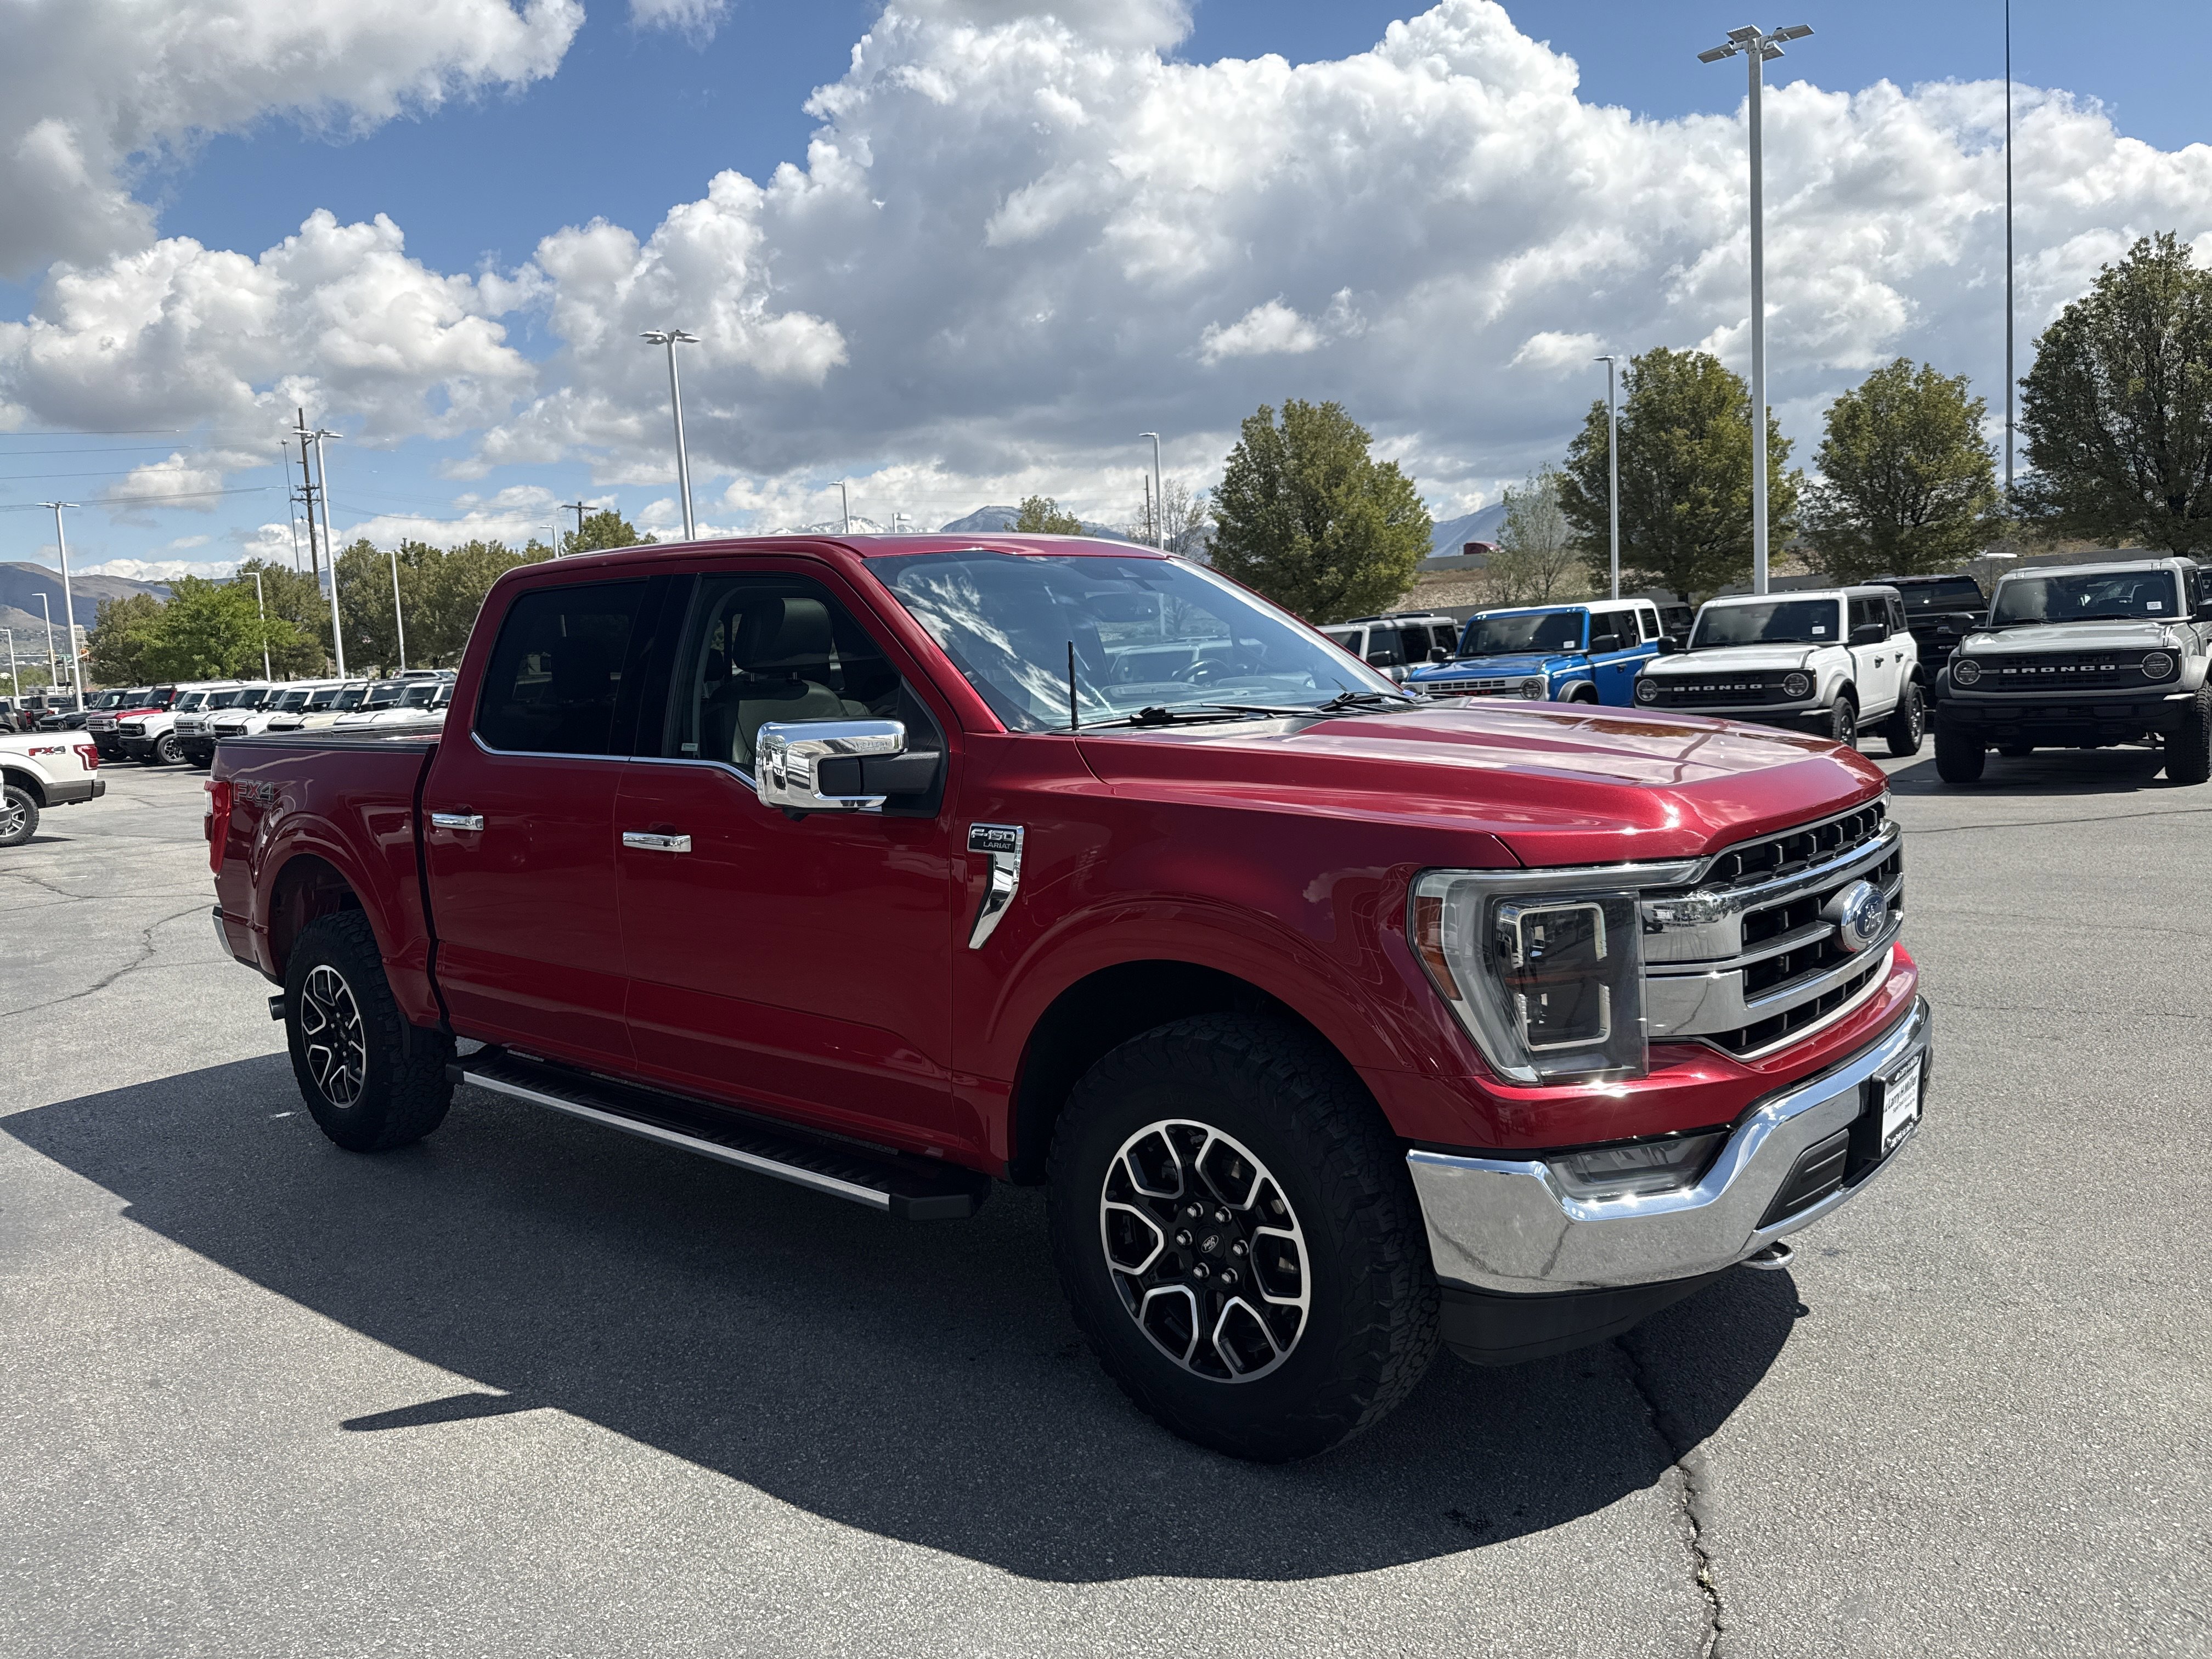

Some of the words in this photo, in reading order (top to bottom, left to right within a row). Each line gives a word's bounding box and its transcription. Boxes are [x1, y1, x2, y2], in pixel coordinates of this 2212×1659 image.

[2002, 664, 2115, 674] BRONCO
[28, 746, 66, 757] FX4
[233, 778, 274, 805] FX4
[971, 828, 1015, 842] F-150
[983, 841, 1011, 849] LARIAT
[1888, 1091, 1900, 1110] Larry
[1900, 1085, 1905, 1098] H
